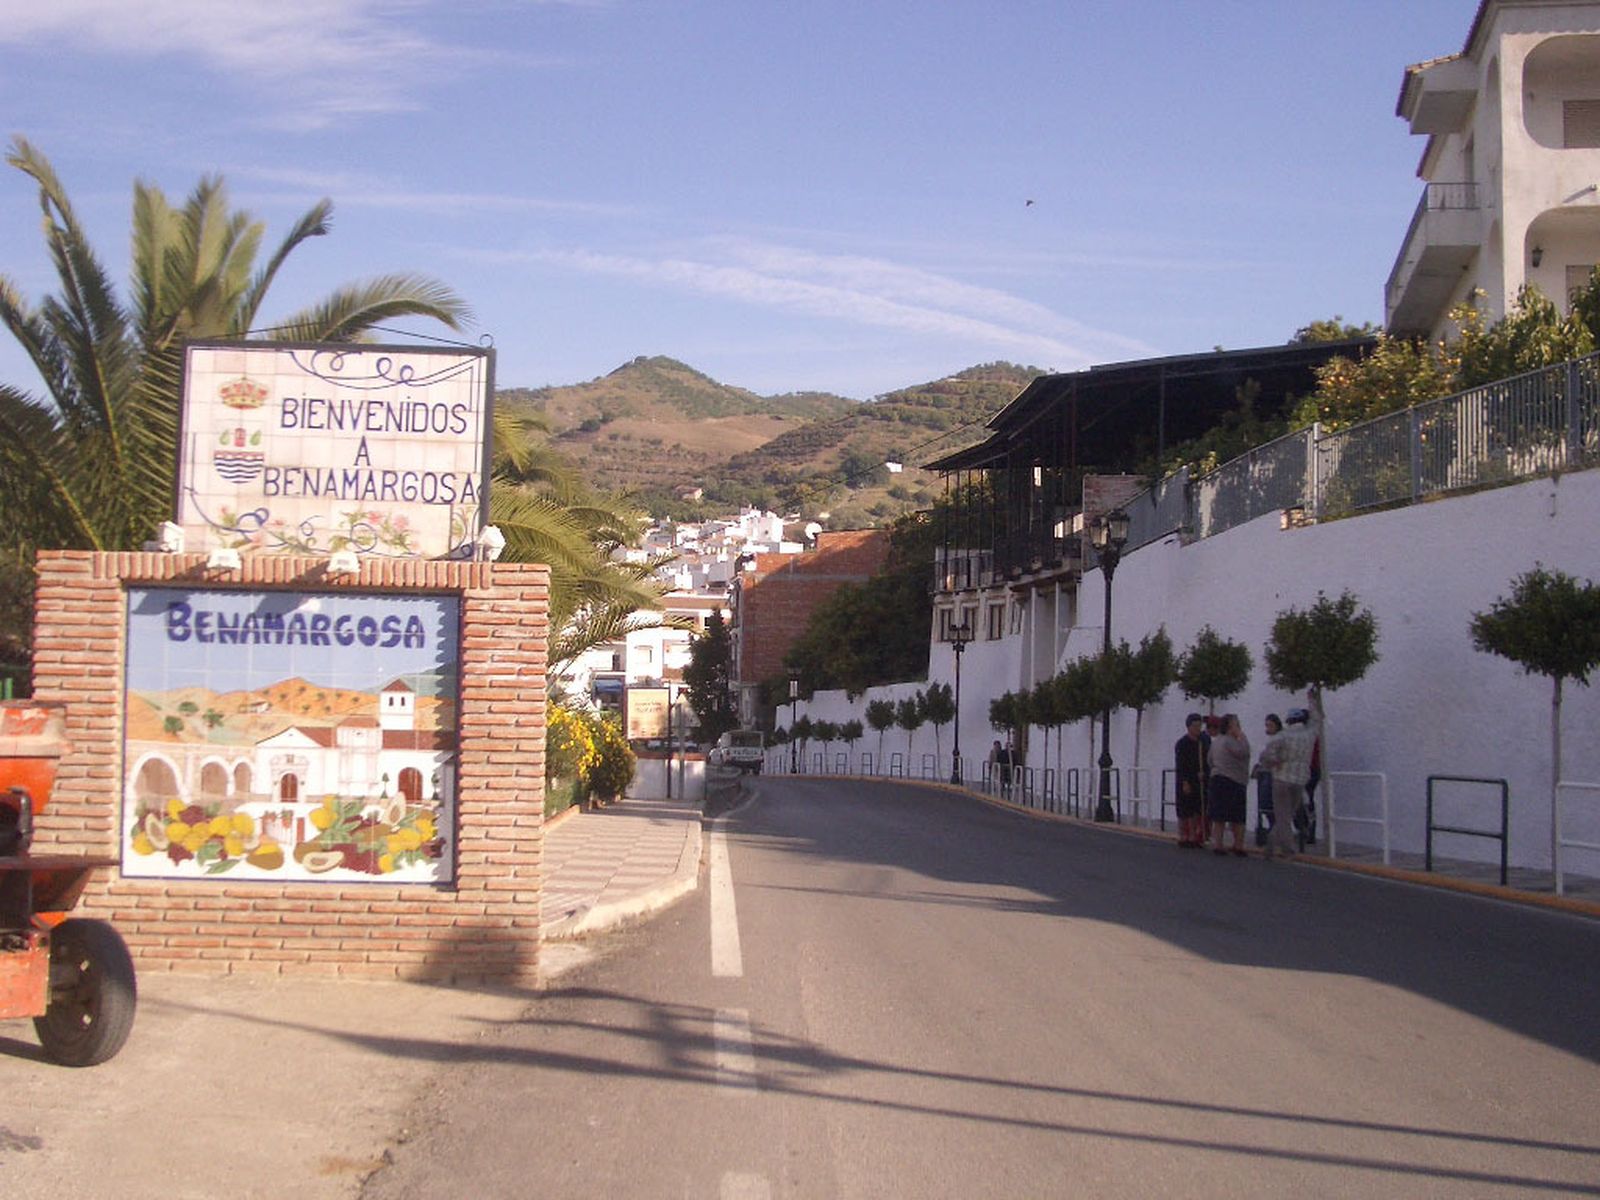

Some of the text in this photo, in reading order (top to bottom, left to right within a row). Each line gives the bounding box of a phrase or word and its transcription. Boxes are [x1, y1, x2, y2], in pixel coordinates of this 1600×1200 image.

[280, 393, 468, 435] BIENVENIDOS
[353, 435, 372, 467] A
[264, 467, 477, 504] BENAMARGOSA
[167, 601, 426, 649] BENAMARGOSA
